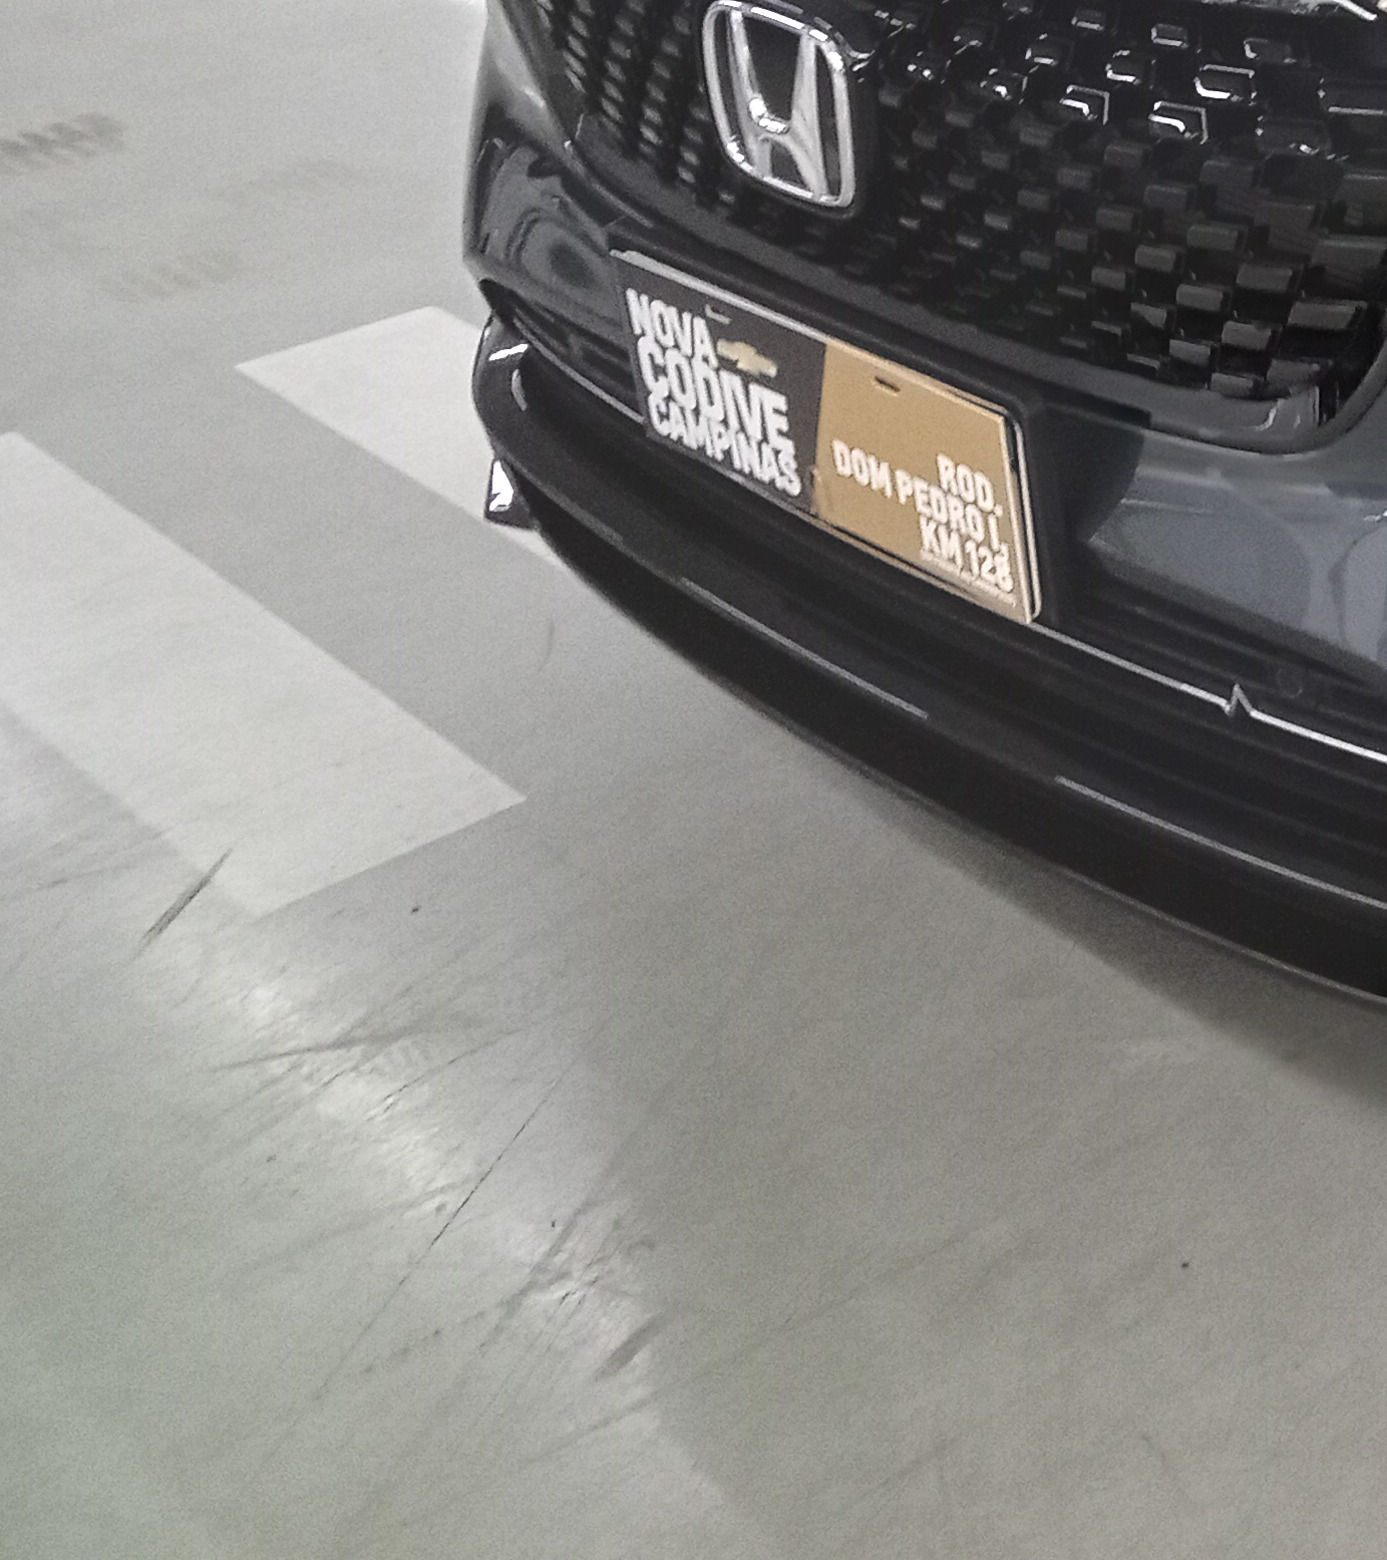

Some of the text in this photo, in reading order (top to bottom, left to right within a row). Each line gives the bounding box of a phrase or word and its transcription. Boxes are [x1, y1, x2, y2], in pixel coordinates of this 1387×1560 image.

[626, 288, 718, 369] NOVA
[637, 336, 789, 445] CODIVE
[648, 392, 802, 497] CAMPINAS
[936, 453, 1004, 518] ROD.
[831, 439, 893, 499] DOM
[894, 468, 986, 545] PEDRO
[919, 513, 1014, 594] KM 128
